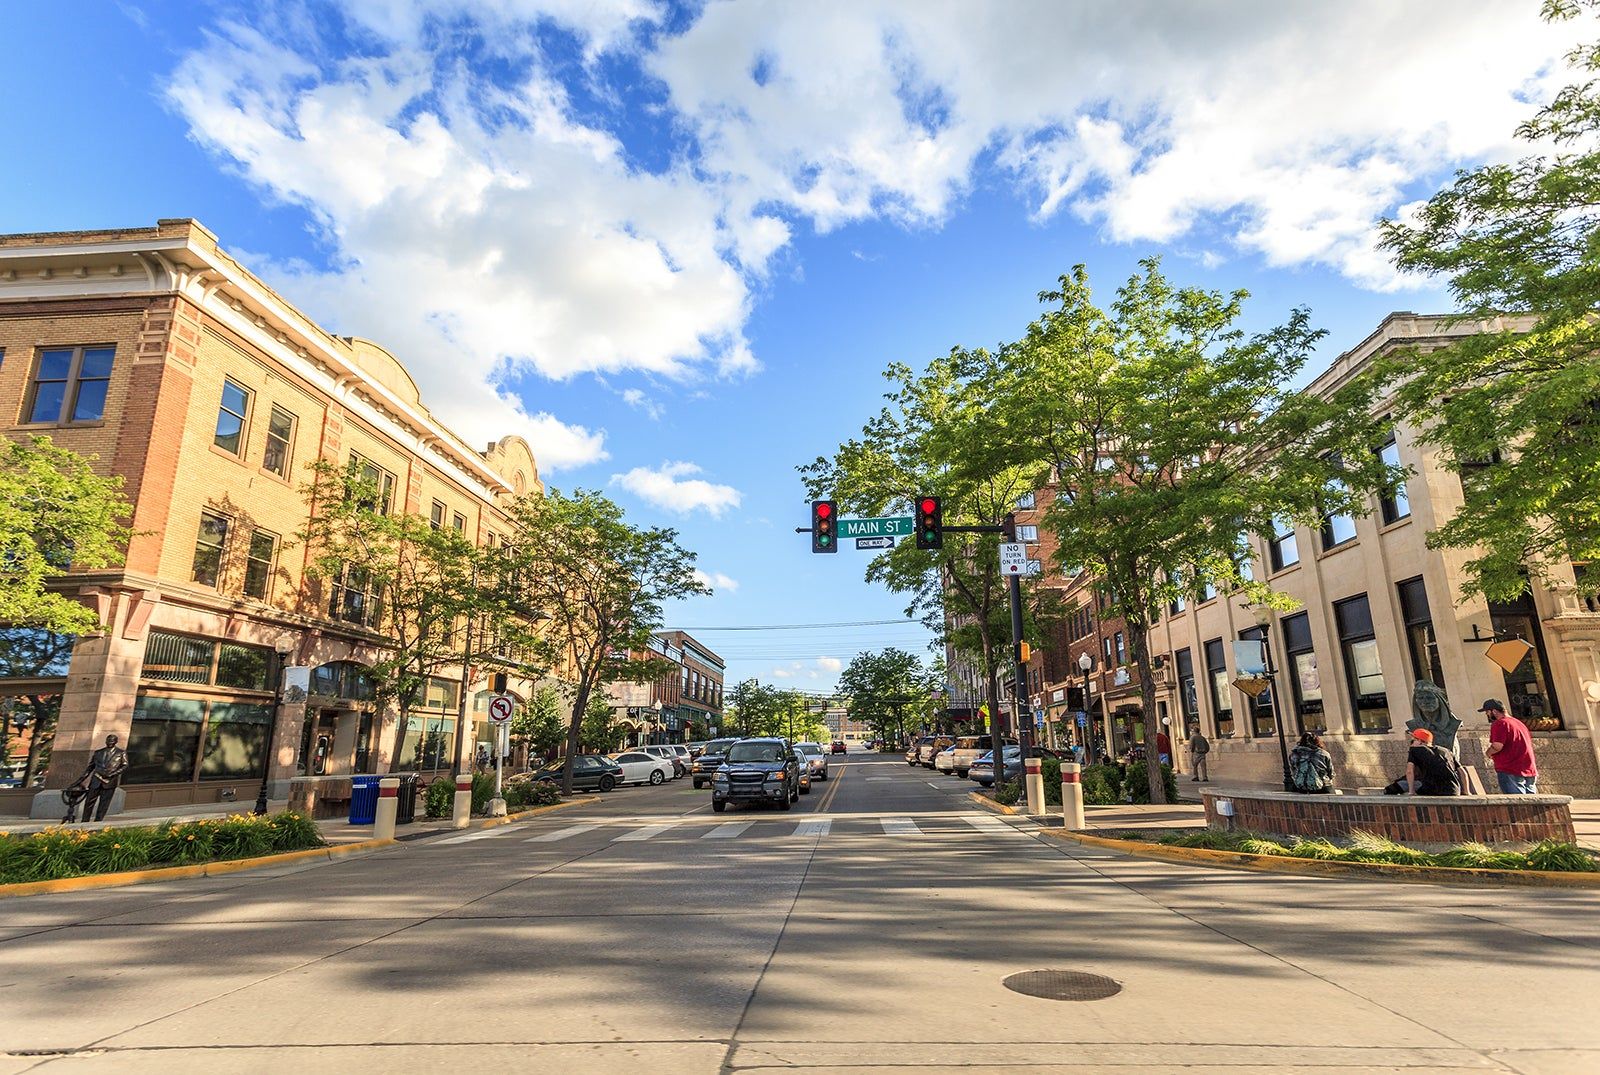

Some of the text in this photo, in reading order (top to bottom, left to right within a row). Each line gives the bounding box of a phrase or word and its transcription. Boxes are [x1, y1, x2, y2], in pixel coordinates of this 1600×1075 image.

[848, 520, 901, 534] MAIN ST
[1512, 693, 1544, 705] OPEN
